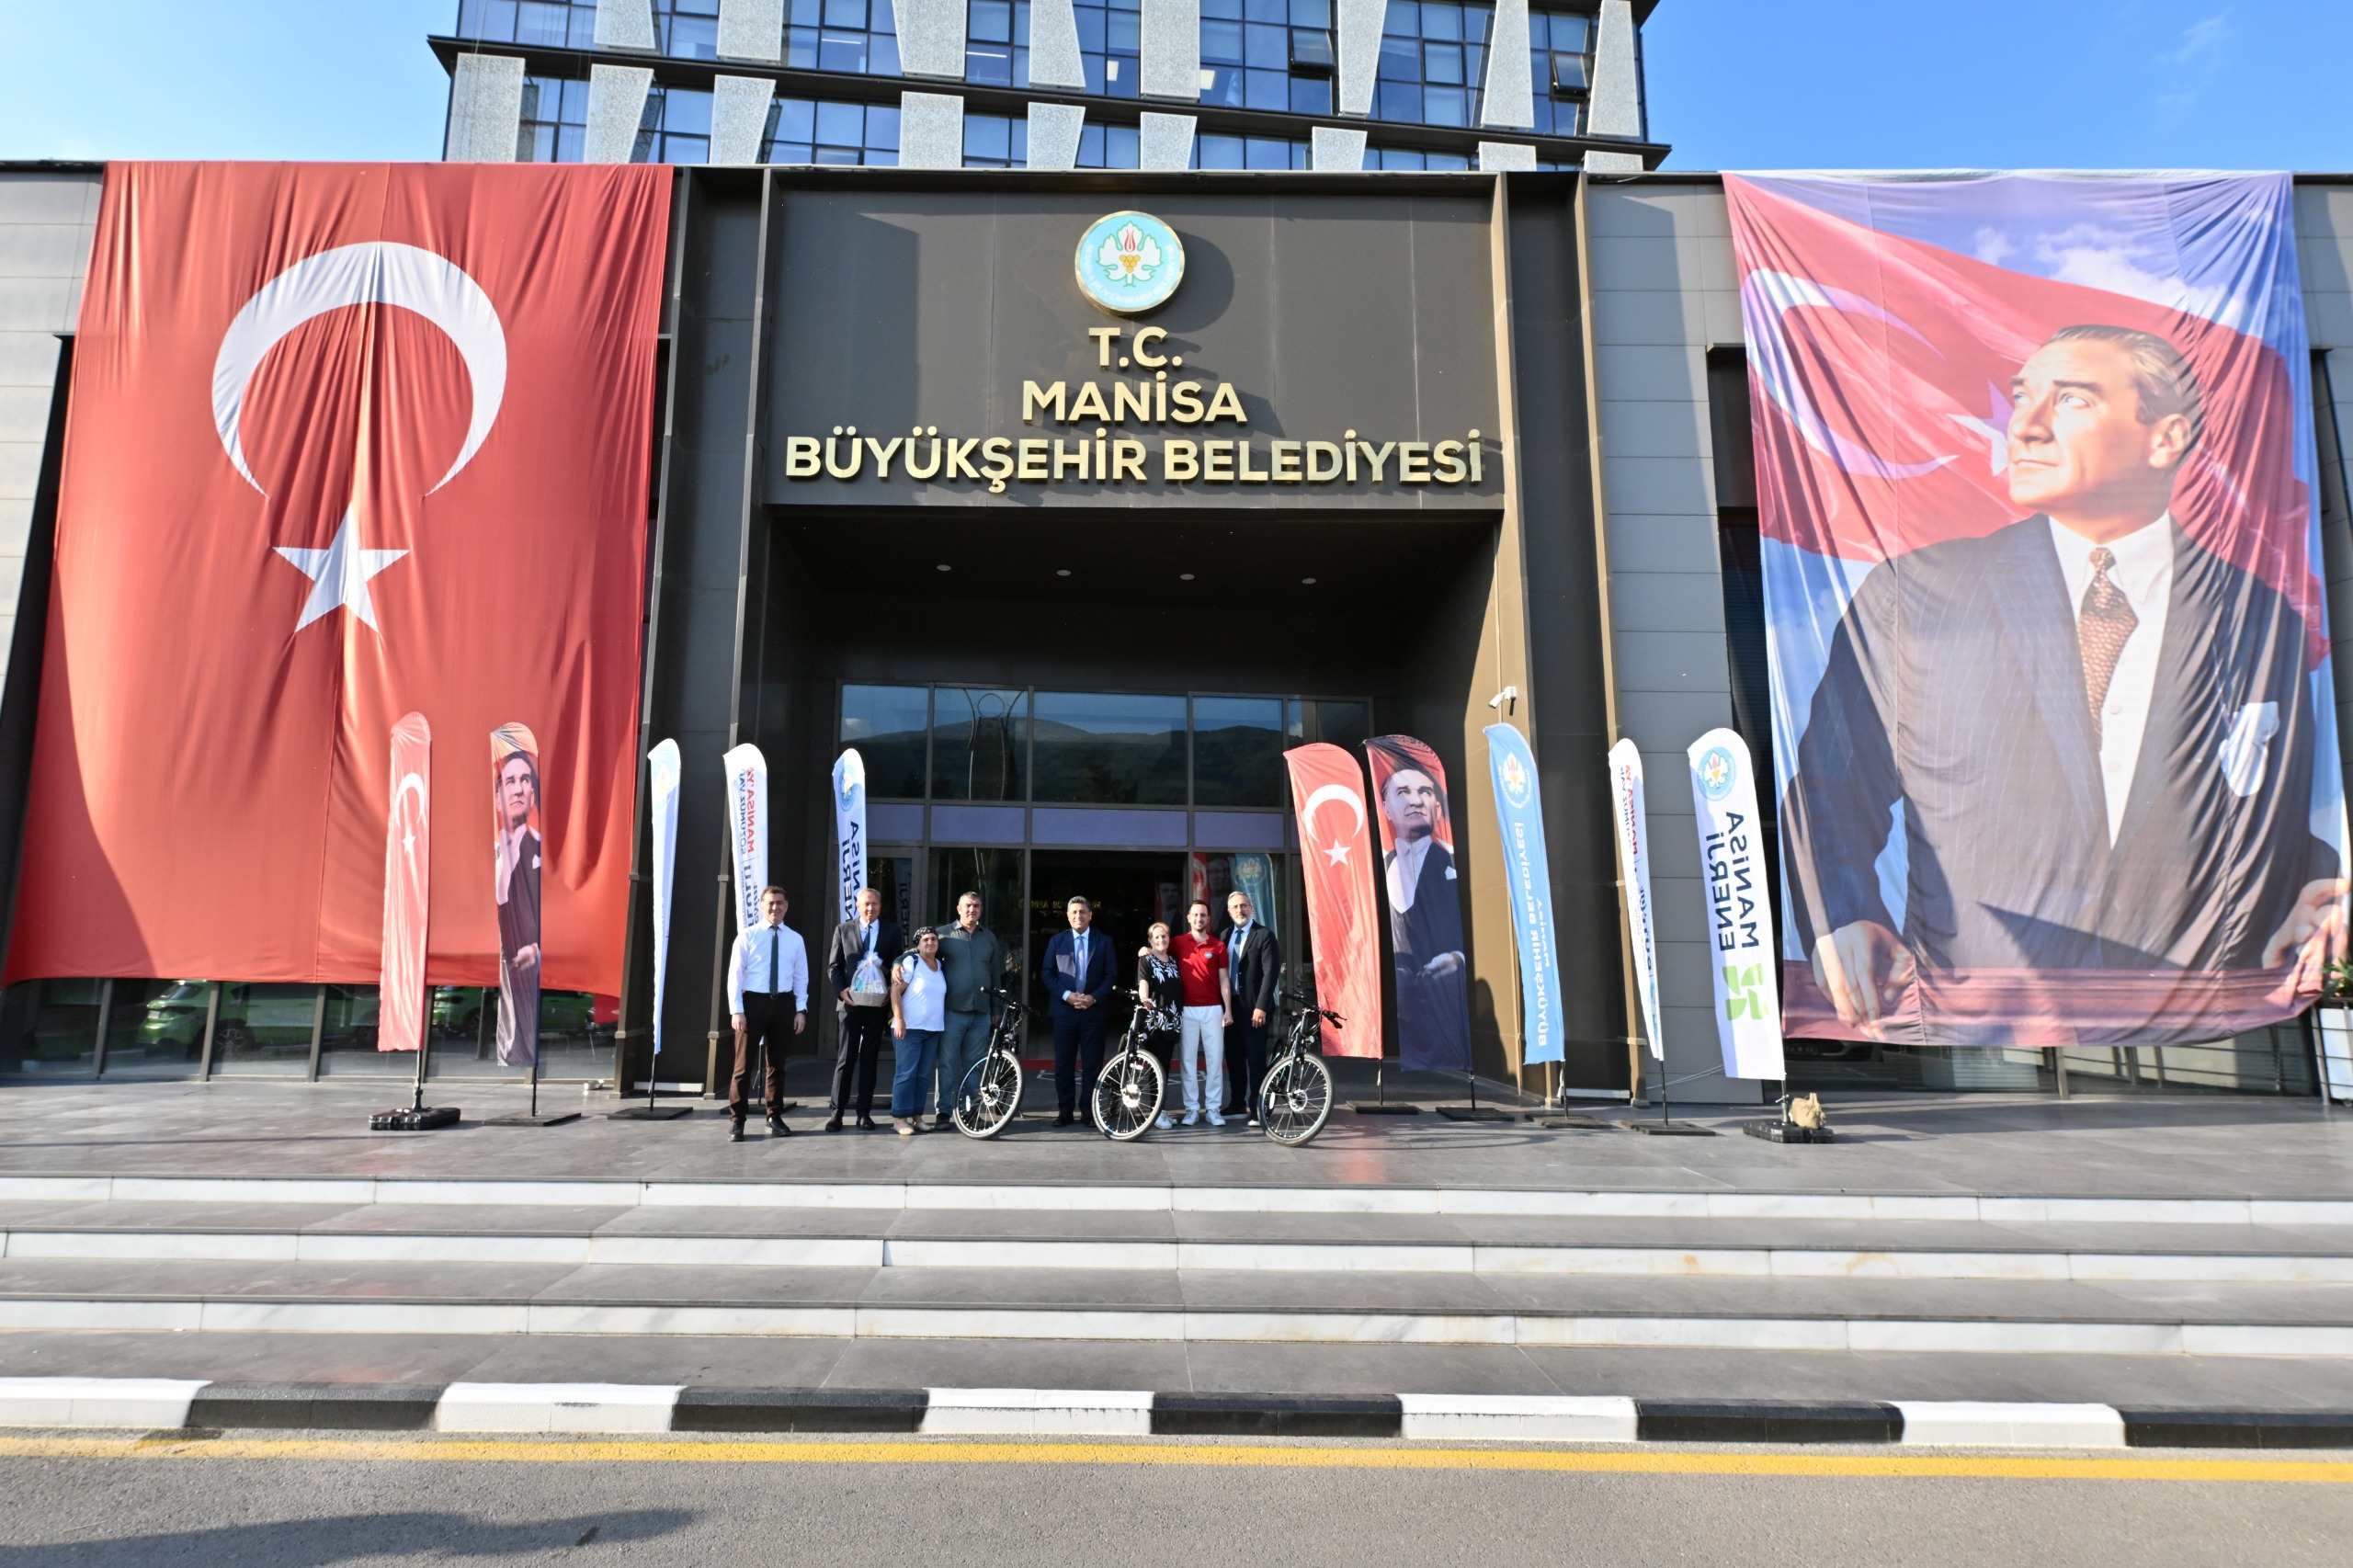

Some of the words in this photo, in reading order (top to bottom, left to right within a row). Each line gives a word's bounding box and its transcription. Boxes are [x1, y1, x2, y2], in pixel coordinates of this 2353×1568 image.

[1088, 326, 1183, 368] T.C.
[1022, 370, 1248, 423] MANİSA
[786, 426, 1147, 494] BÜYÜKŞEHİR
[1164, 428, 1482, 483] BELEDİYESİ
